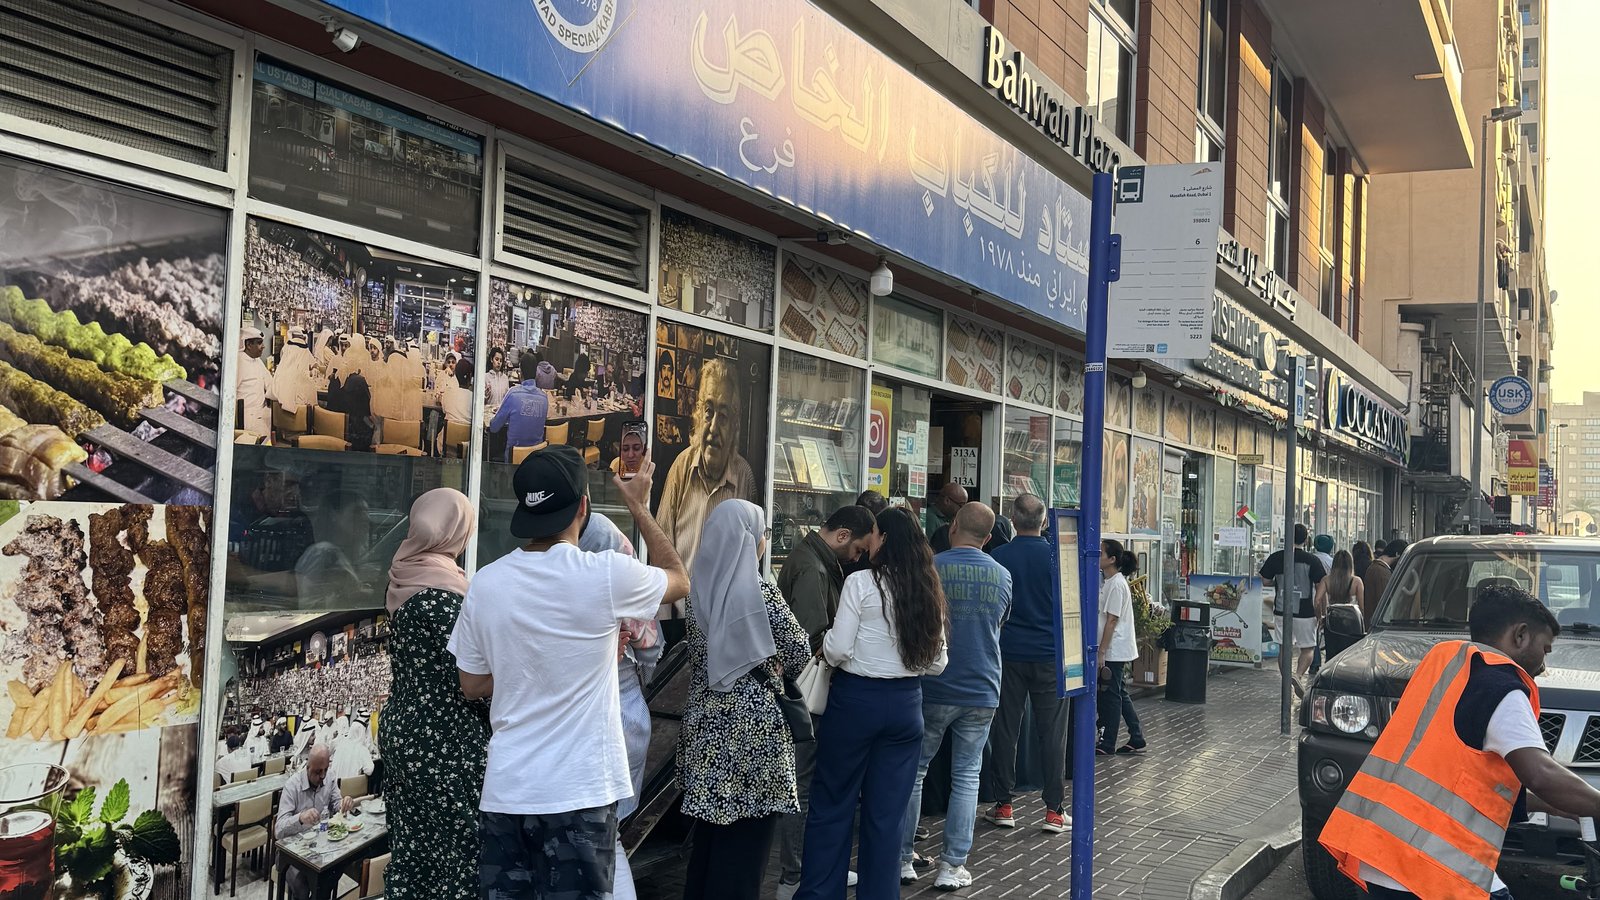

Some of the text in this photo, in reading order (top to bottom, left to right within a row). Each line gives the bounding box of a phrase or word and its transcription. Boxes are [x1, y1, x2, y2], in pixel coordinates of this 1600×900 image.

[538, 0, 615, 47] TAD SPECIAL KABA
[267, 66, 299, 86] USTAD
[300, 77, 341, 99] SPECIAL
[342, 92, 372, 112] KABAB
[691, 10, 890, 164] الخاص
[983, 25, 1072, 148] Bahwan
[738, 117, 795, 174] فرع
[980, 235, 1014, 275] ١٩٧٨
[1017, 249, 1041, 288] منذ
[1212, 294, 1260, 360] RISHMAH
[1498, 388, 1524, 398] USK
[953, 448, 976, 457] 313A
[526, 490, 546, 503] NIKE
[952, 476, 975, 486] 313A
[940, 563, 1000, 585] AMERICAN
[980, 584, 1000, 604] USA
